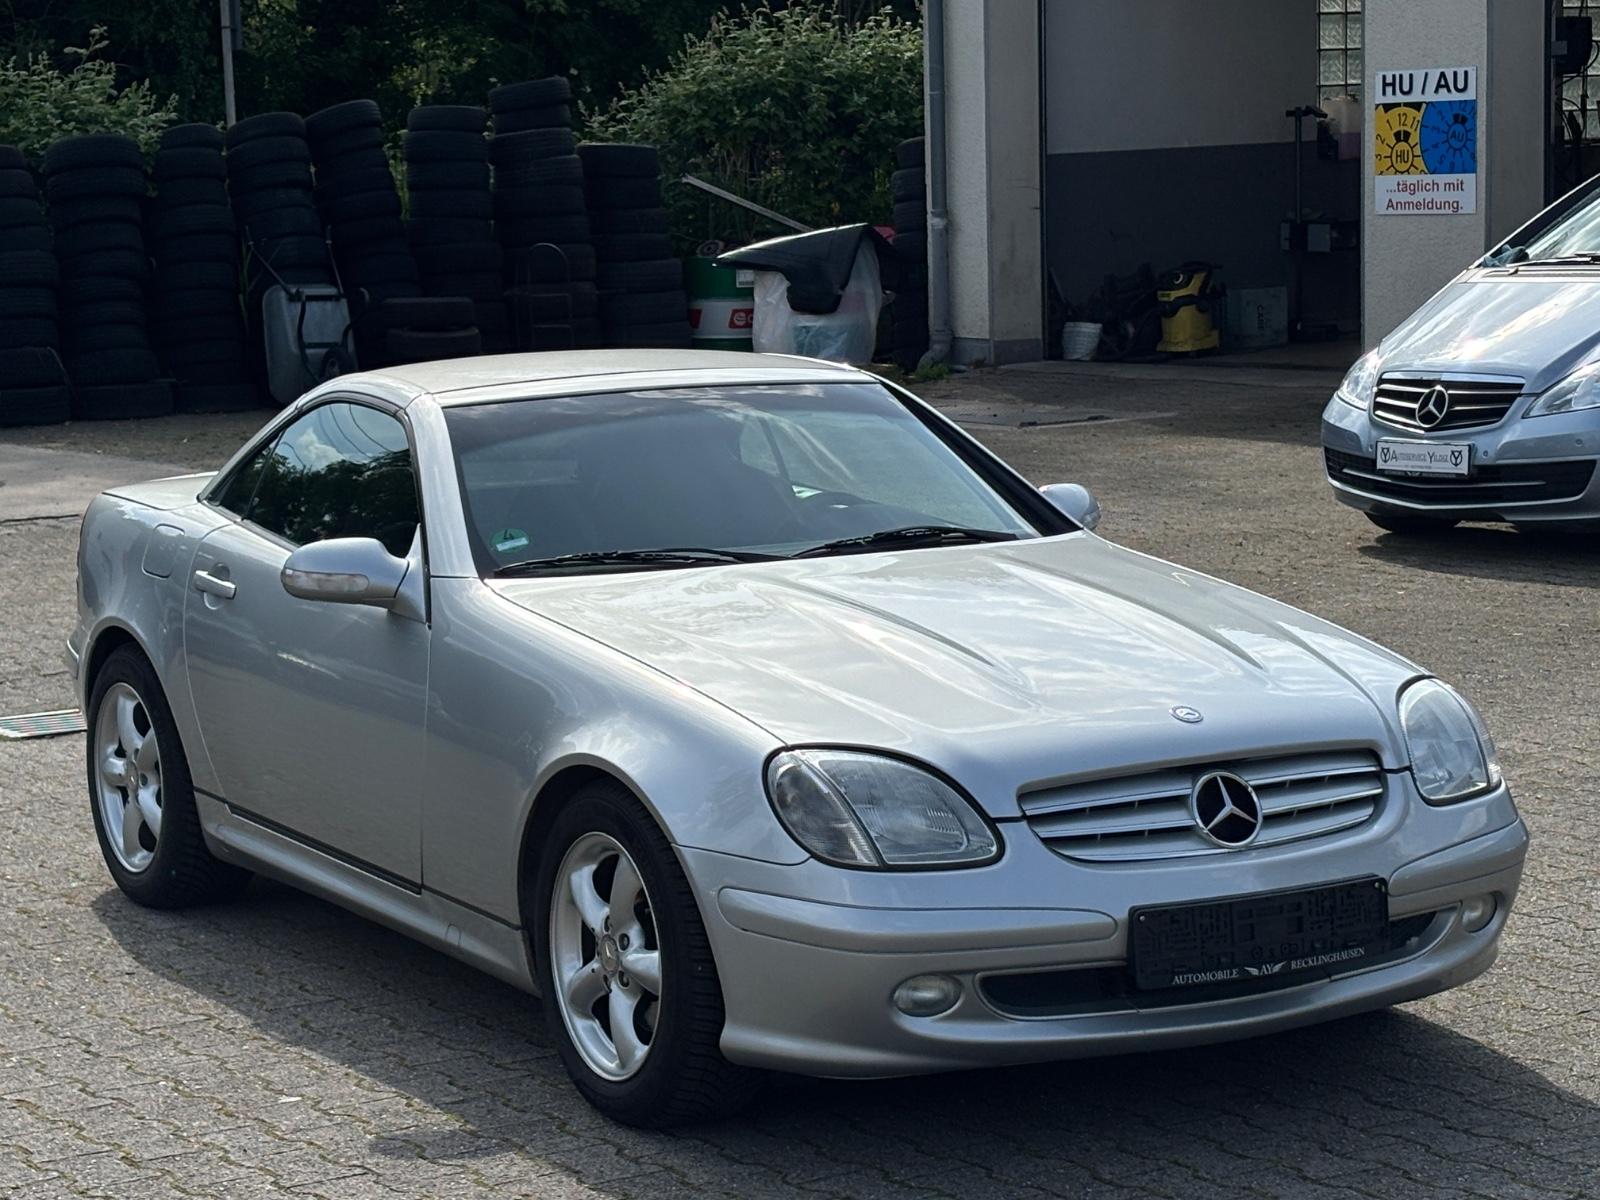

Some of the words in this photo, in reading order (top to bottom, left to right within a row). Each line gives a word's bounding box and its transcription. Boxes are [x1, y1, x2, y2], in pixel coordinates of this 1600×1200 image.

[1382, 73, 1413, 96] HU
[1434, 70, 1468, 94] AU
[1397, 112, 1408, 127] 12
[1396, 148, 1410, 164] HU
[1444, 179, 1465, 193] mit
[1386, 198, 1463, 213] Anmeldung.
[1172, 968, 1240, 985] AUTOMOBILE
[1291, 946, 1365, 970] RECKLINGHAUSEN
